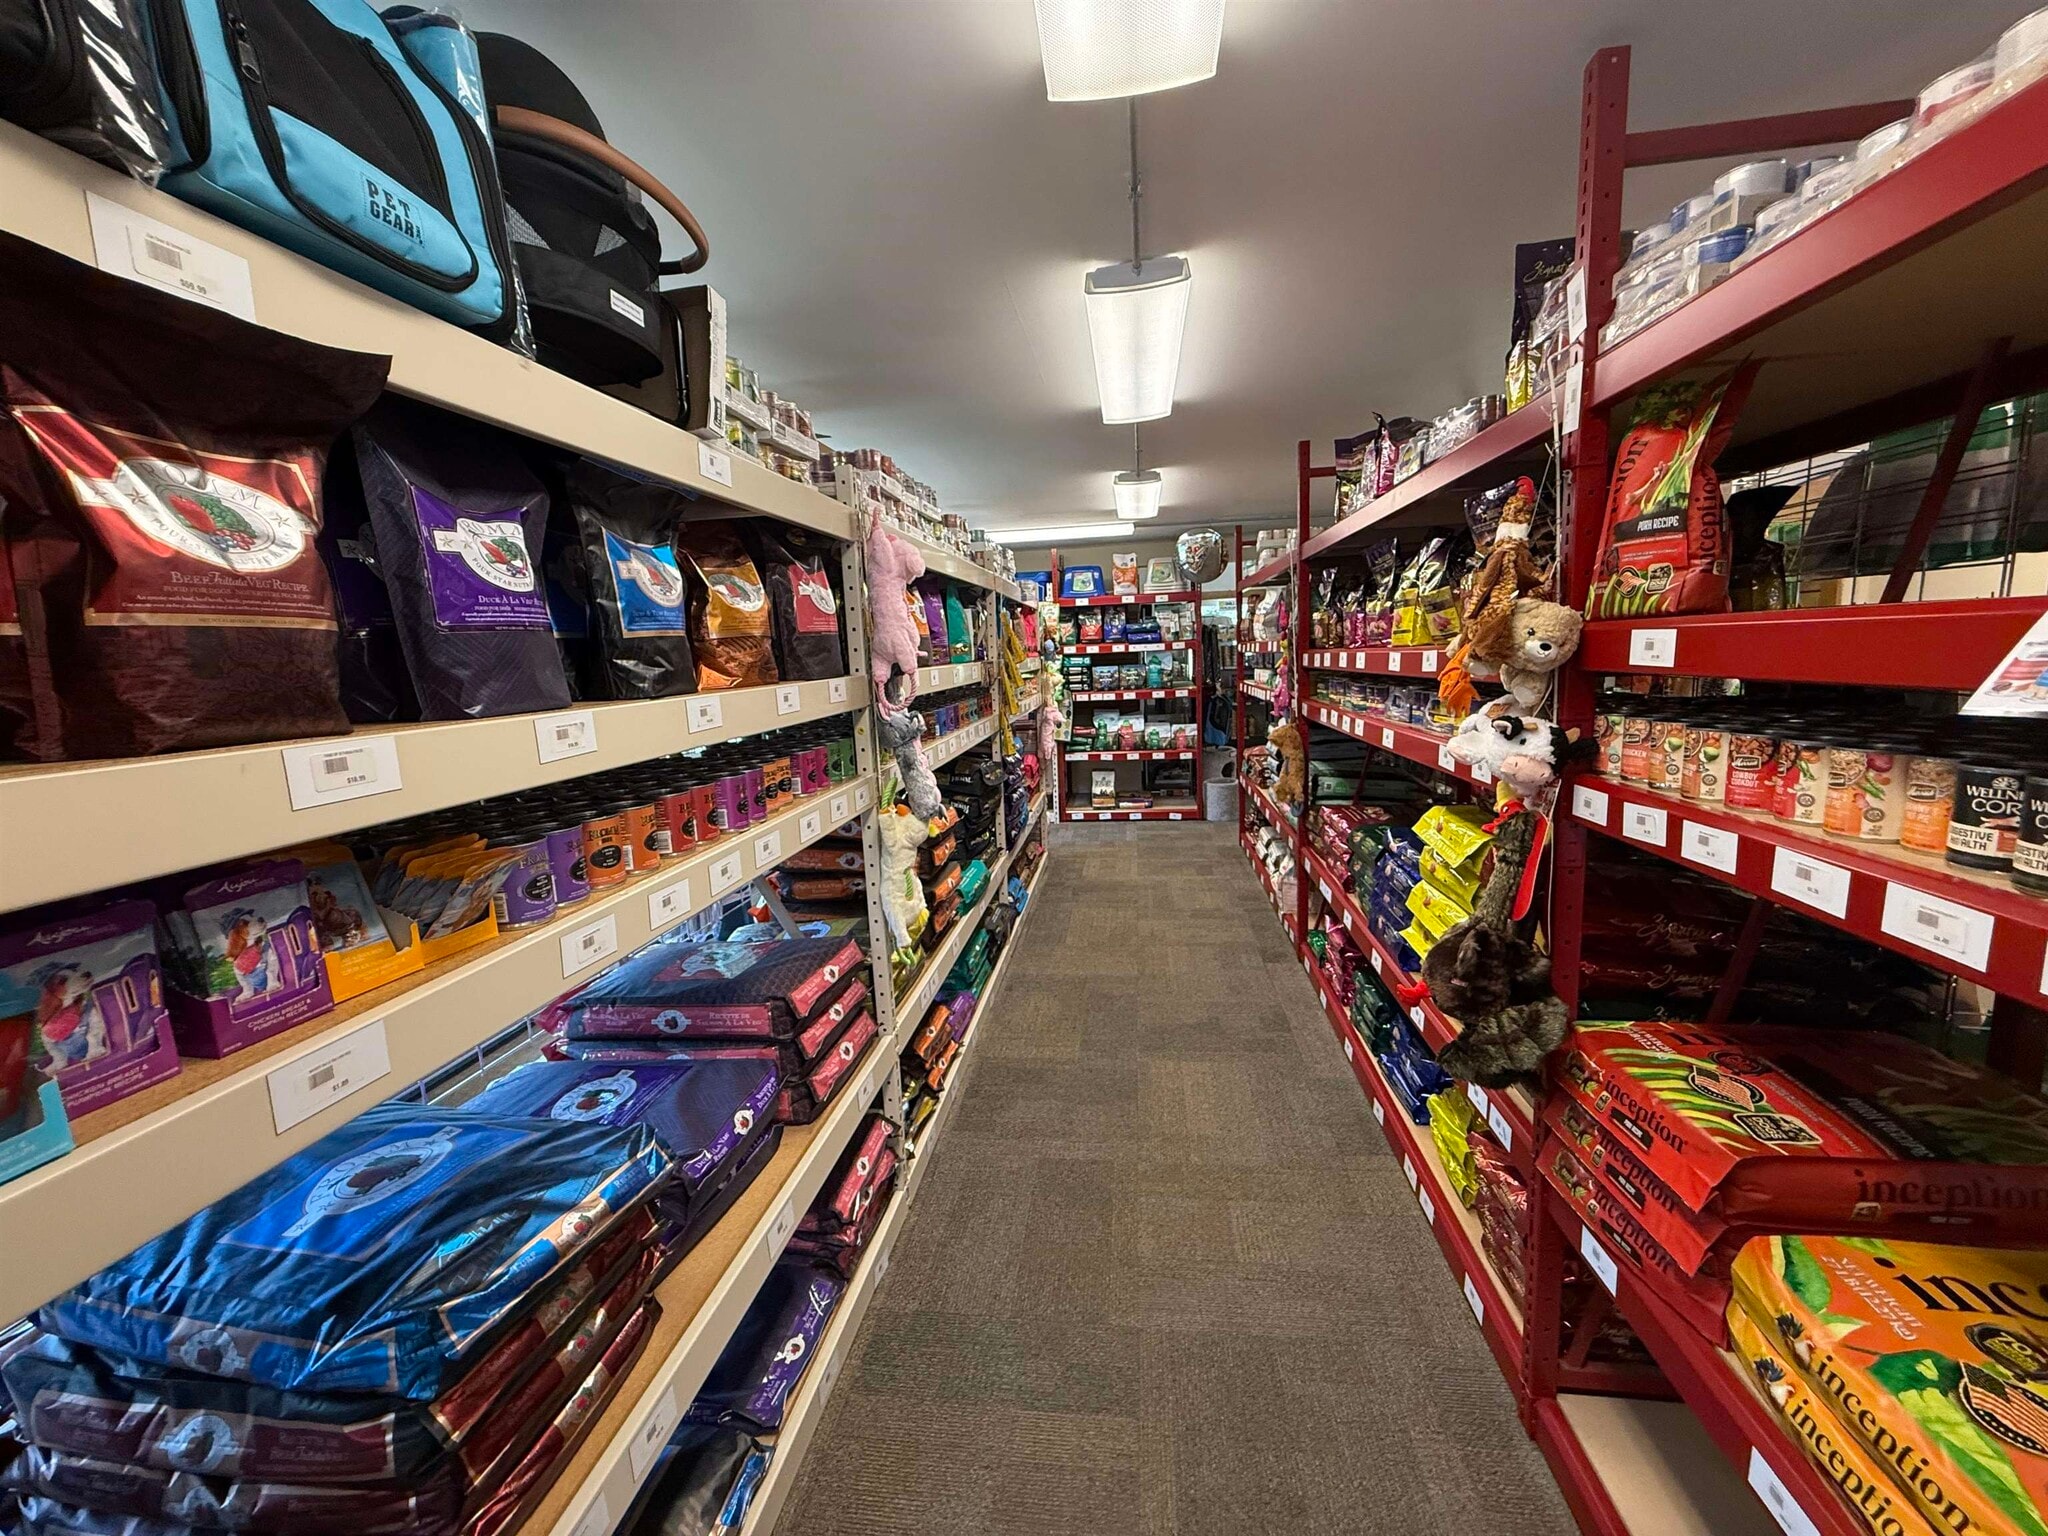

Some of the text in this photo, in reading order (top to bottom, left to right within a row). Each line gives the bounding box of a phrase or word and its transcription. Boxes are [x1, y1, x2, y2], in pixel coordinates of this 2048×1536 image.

[366, 178, 411, 219] PET
[1653, 515, 1680, 530] RECIPE
[1732, 771, 1759, 780] COWBOY
[1966, 785, 2024, 800] WELLN
[1971, 798, 2021, 815] COR
[1605, 1074, 1684, 1153] inception
[1599, 1132, 1676, 1213] inception
[1865, 1280, 1925, 1328] WEIGHT
[1816, 1354, 1971, 1534] inception
[1790, 1399, 1905, 1536] inceptio
